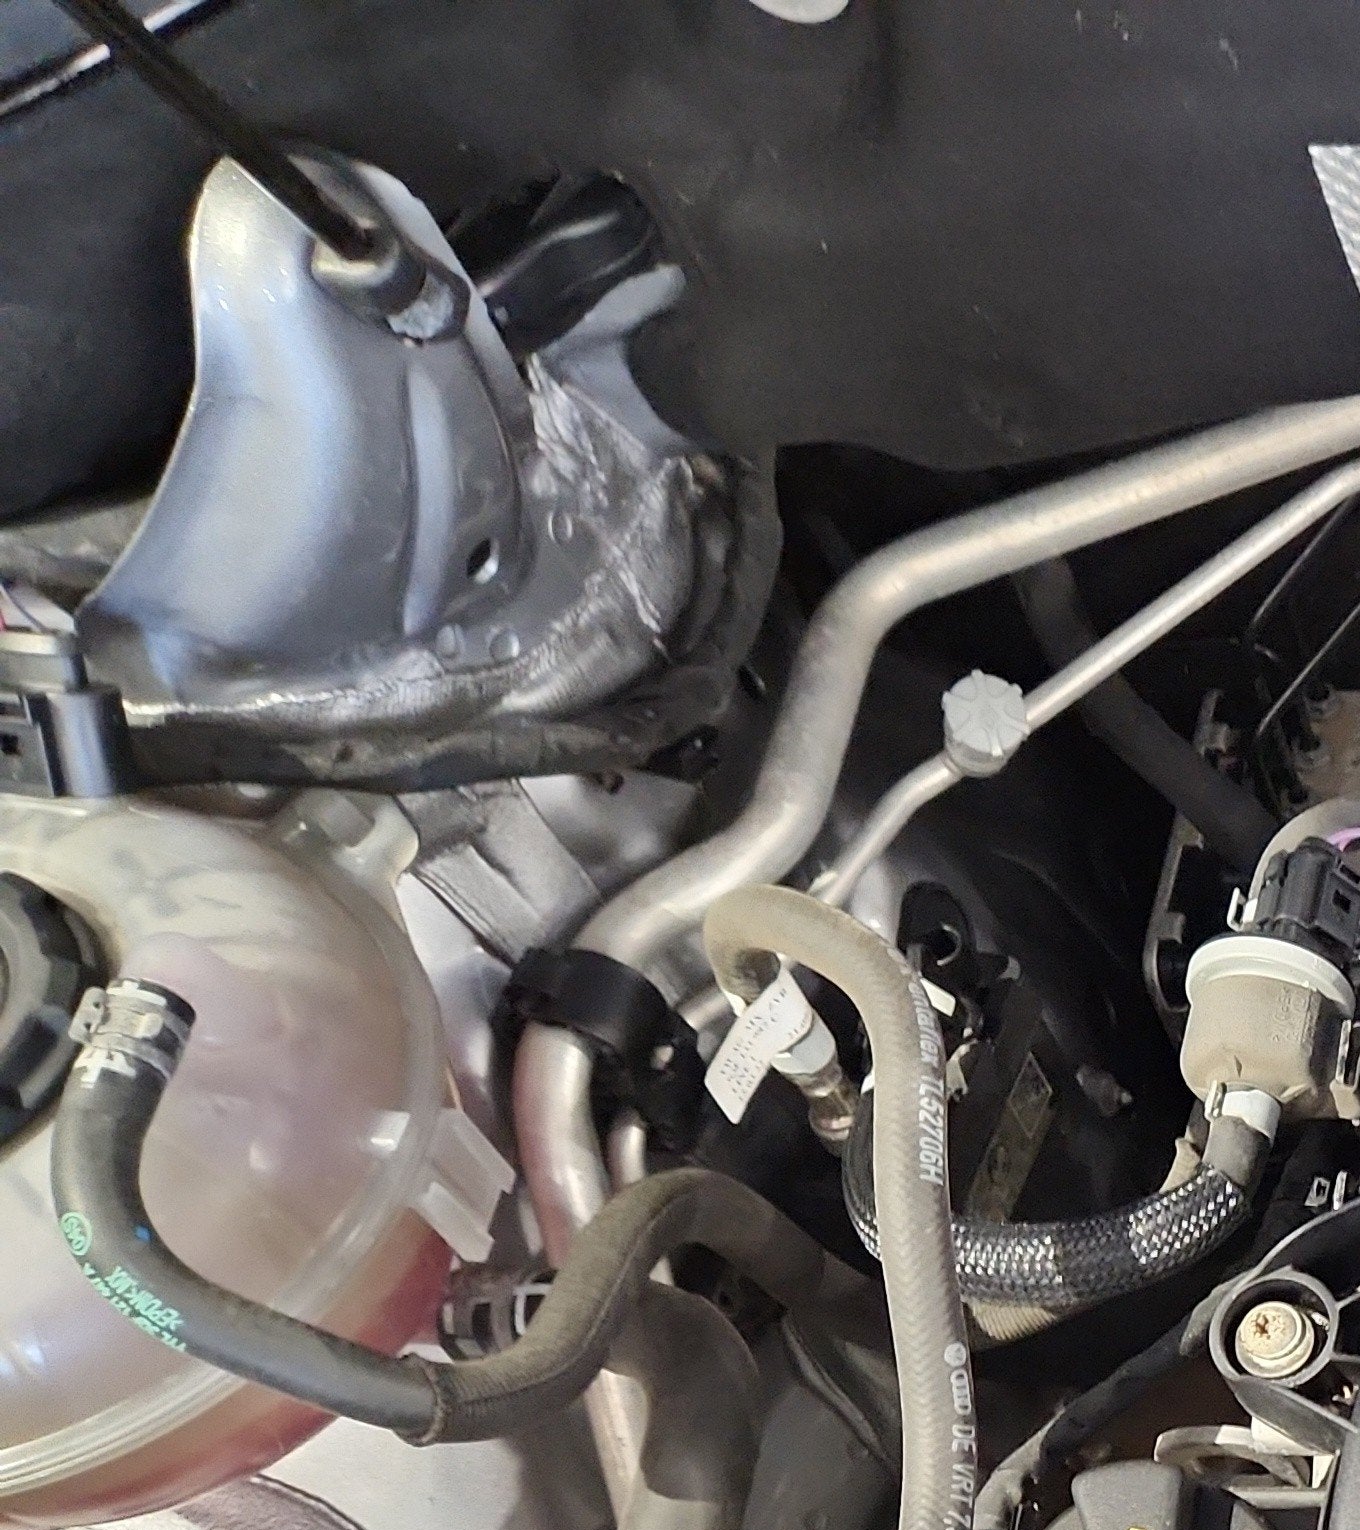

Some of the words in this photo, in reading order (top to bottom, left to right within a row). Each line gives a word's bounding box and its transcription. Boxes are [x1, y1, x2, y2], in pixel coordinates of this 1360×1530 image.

[918, 1072, 944, 1189] TL52706H
[949, 1422, 977, 1454] DE
[950, 1461, 974, 1511] VRT
